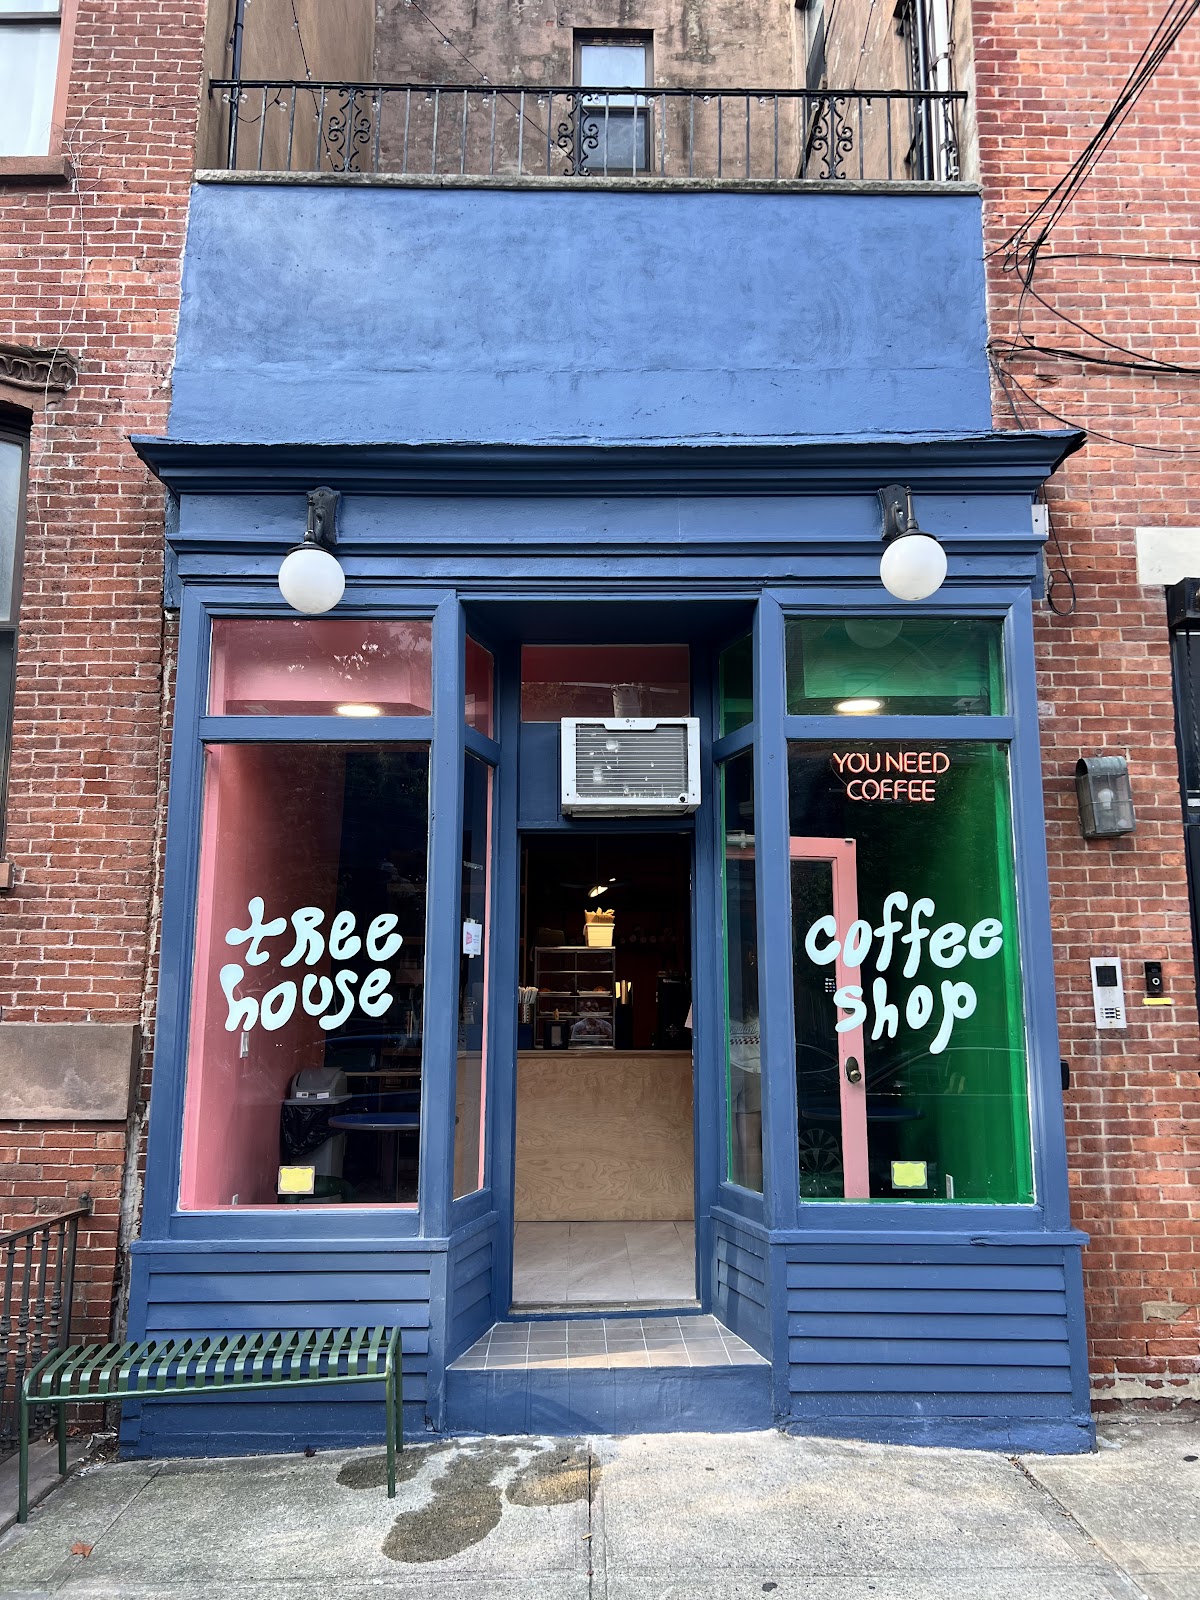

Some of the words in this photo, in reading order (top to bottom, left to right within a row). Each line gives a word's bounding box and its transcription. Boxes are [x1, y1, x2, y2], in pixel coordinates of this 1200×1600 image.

[832, 752, 881, 773] YOU
[885, 752, 950, 773] NEED
[846, 779, 936, 802] COFFEE
[805, 891, 1003, 978] coffee
[220, 963, 394, 1031] house
[833, 977, 977, 1054] shop
